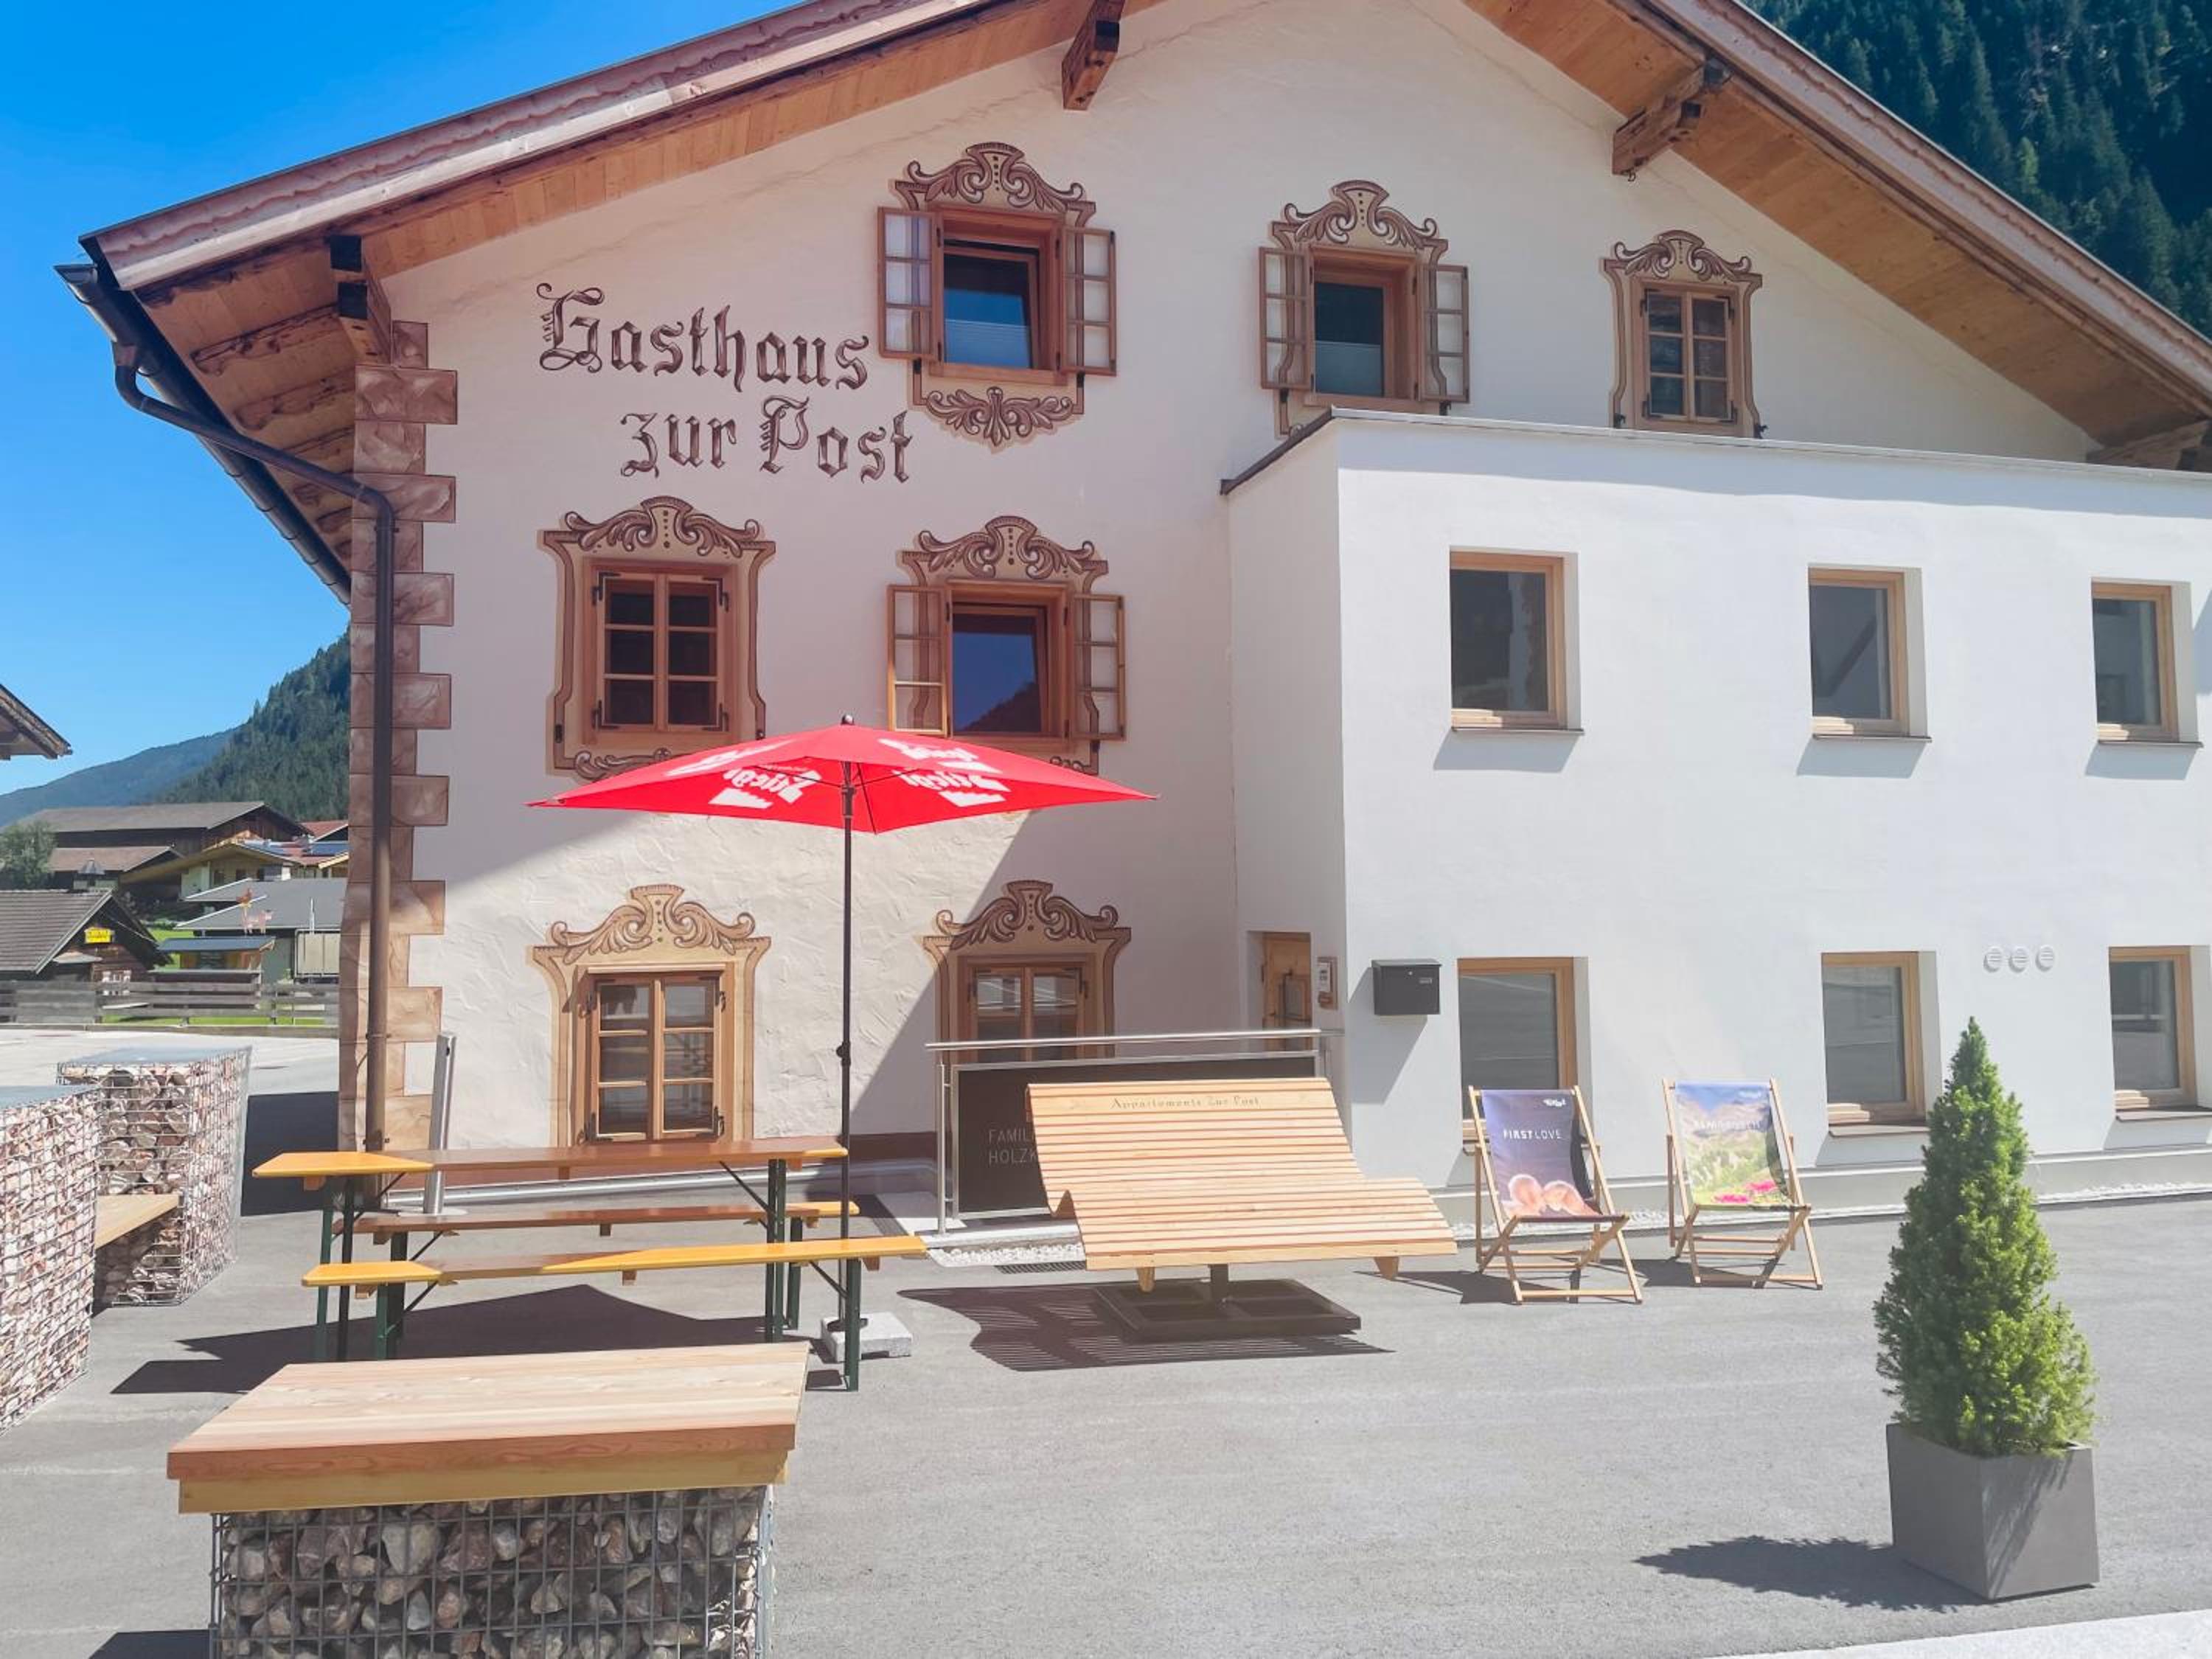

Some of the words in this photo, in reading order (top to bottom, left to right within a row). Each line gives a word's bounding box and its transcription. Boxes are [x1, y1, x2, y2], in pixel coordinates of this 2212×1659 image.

[537, 282, 869, 393] Gasthaus
[759, 396, 914, 484] Post
[1234, 1095, 1261, 1106] Post
[989, 1127, 1032, 1144] FAMIL
